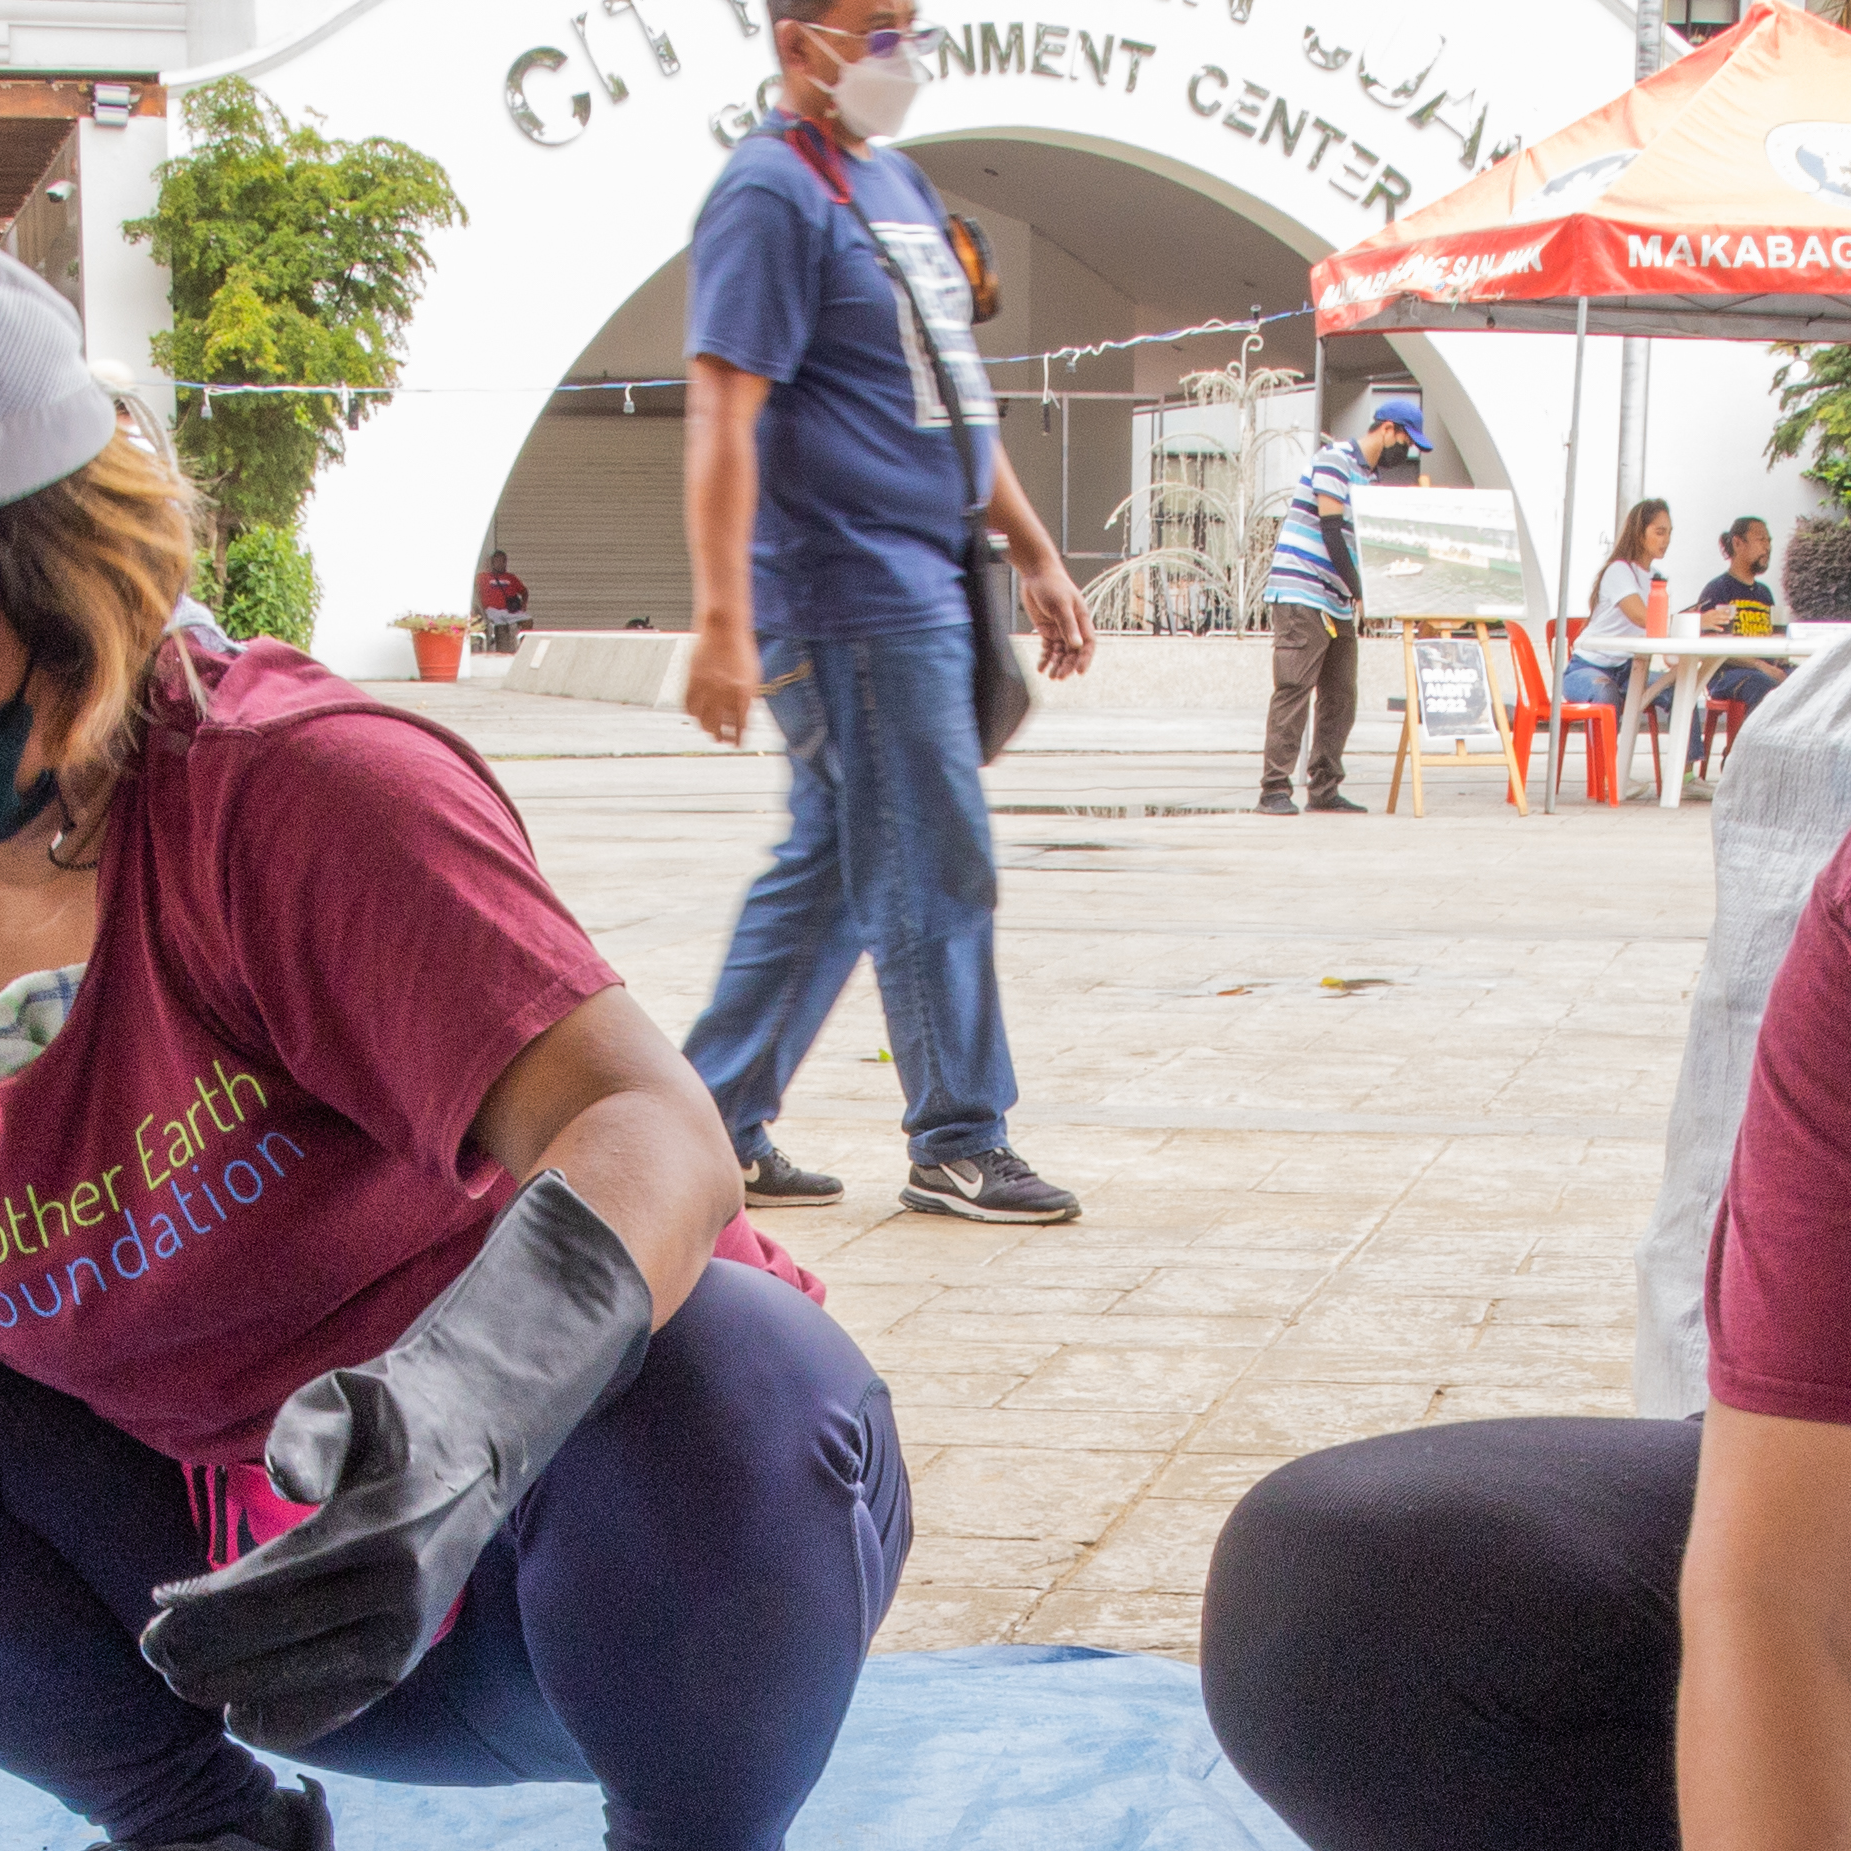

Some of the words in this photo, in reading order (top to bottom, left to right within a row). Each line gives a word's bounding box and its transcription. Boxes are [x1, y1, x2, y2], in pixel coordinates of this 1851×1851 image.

[1186, 63, 1413, 224] CENTER
[1421, 668, 1478, 683] BRAND
[1425, 683, 1473, 698] AUDIT
[1426, 698, 1467, 713] 2022
[135, 1059, 268, 1191] Earth
